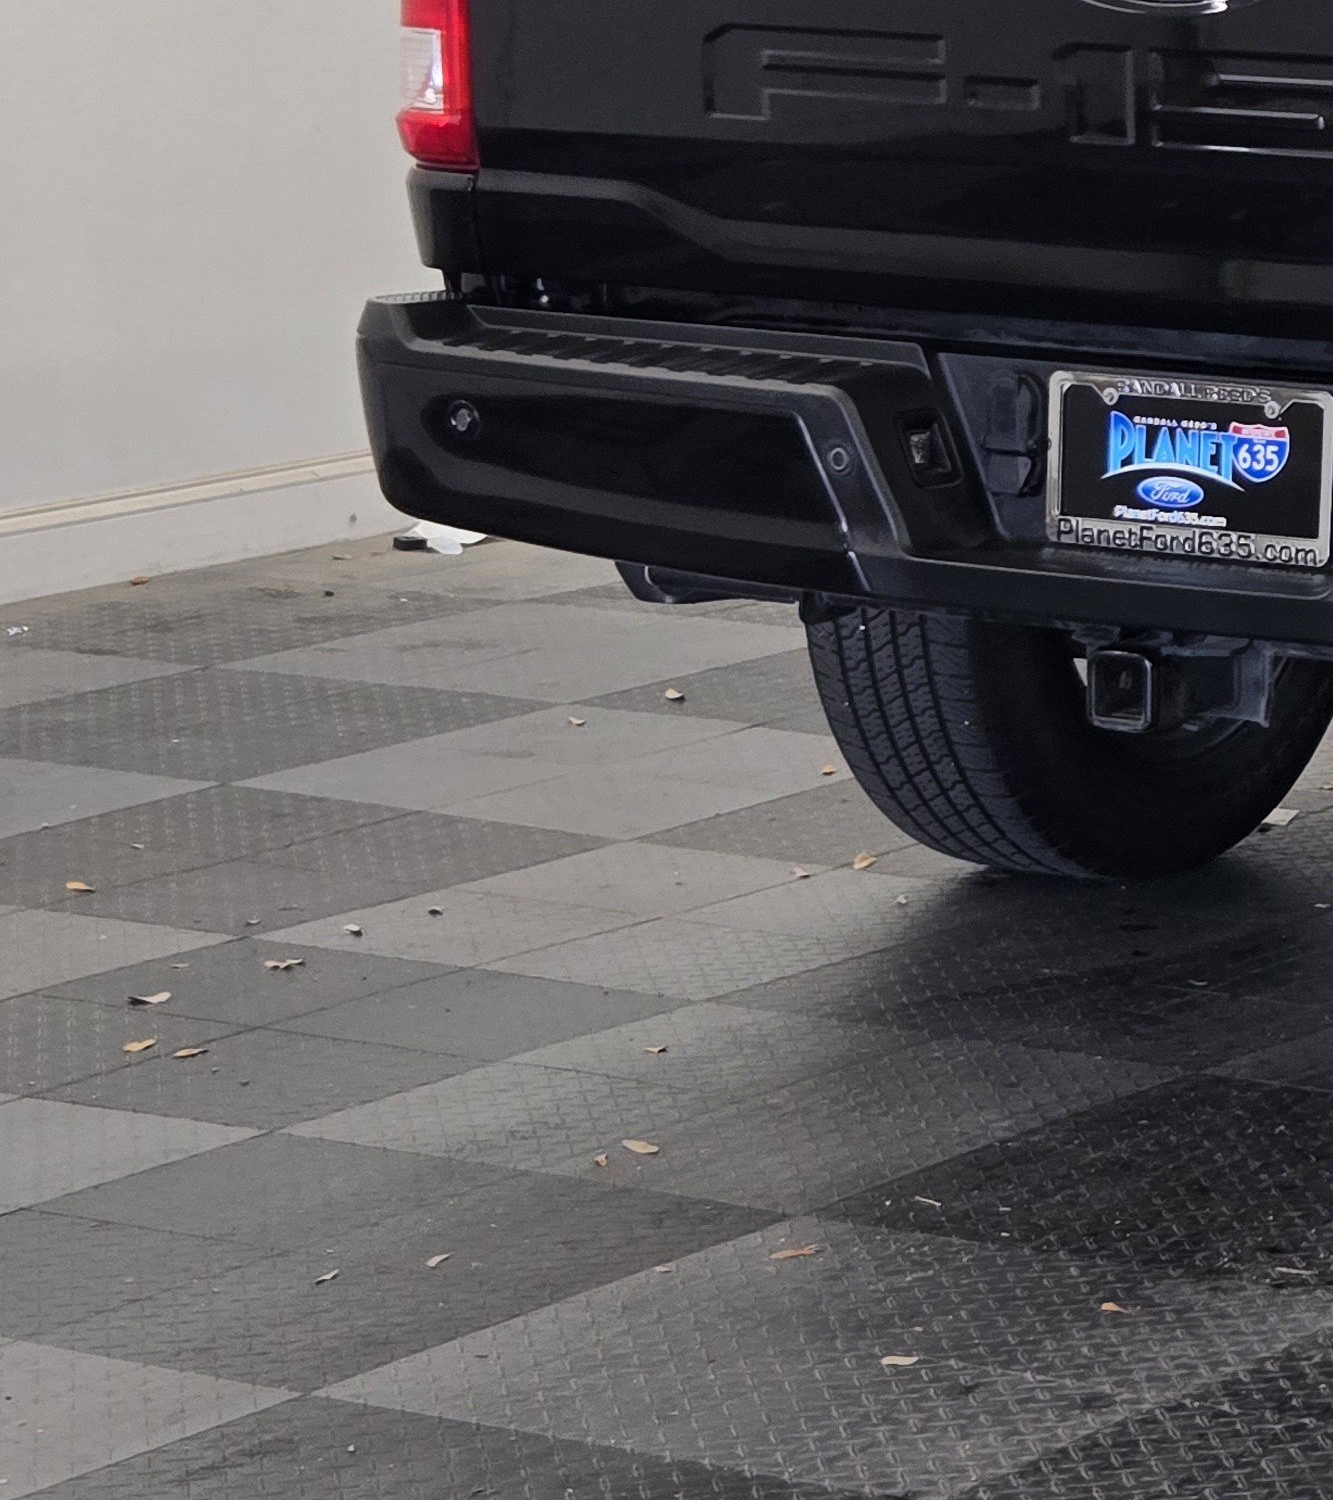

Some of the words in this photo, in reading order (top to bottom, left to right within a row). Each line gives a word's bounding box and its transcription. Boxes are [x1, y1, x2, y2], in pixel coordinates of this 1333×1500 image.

[1107, 410, 1238, 482] PLANET
[1238, 443, 1279, 471] 635
[1149, 483, 1191, 504] Ford
[1055, 518, 1318, 565] PlanetFord635.com
